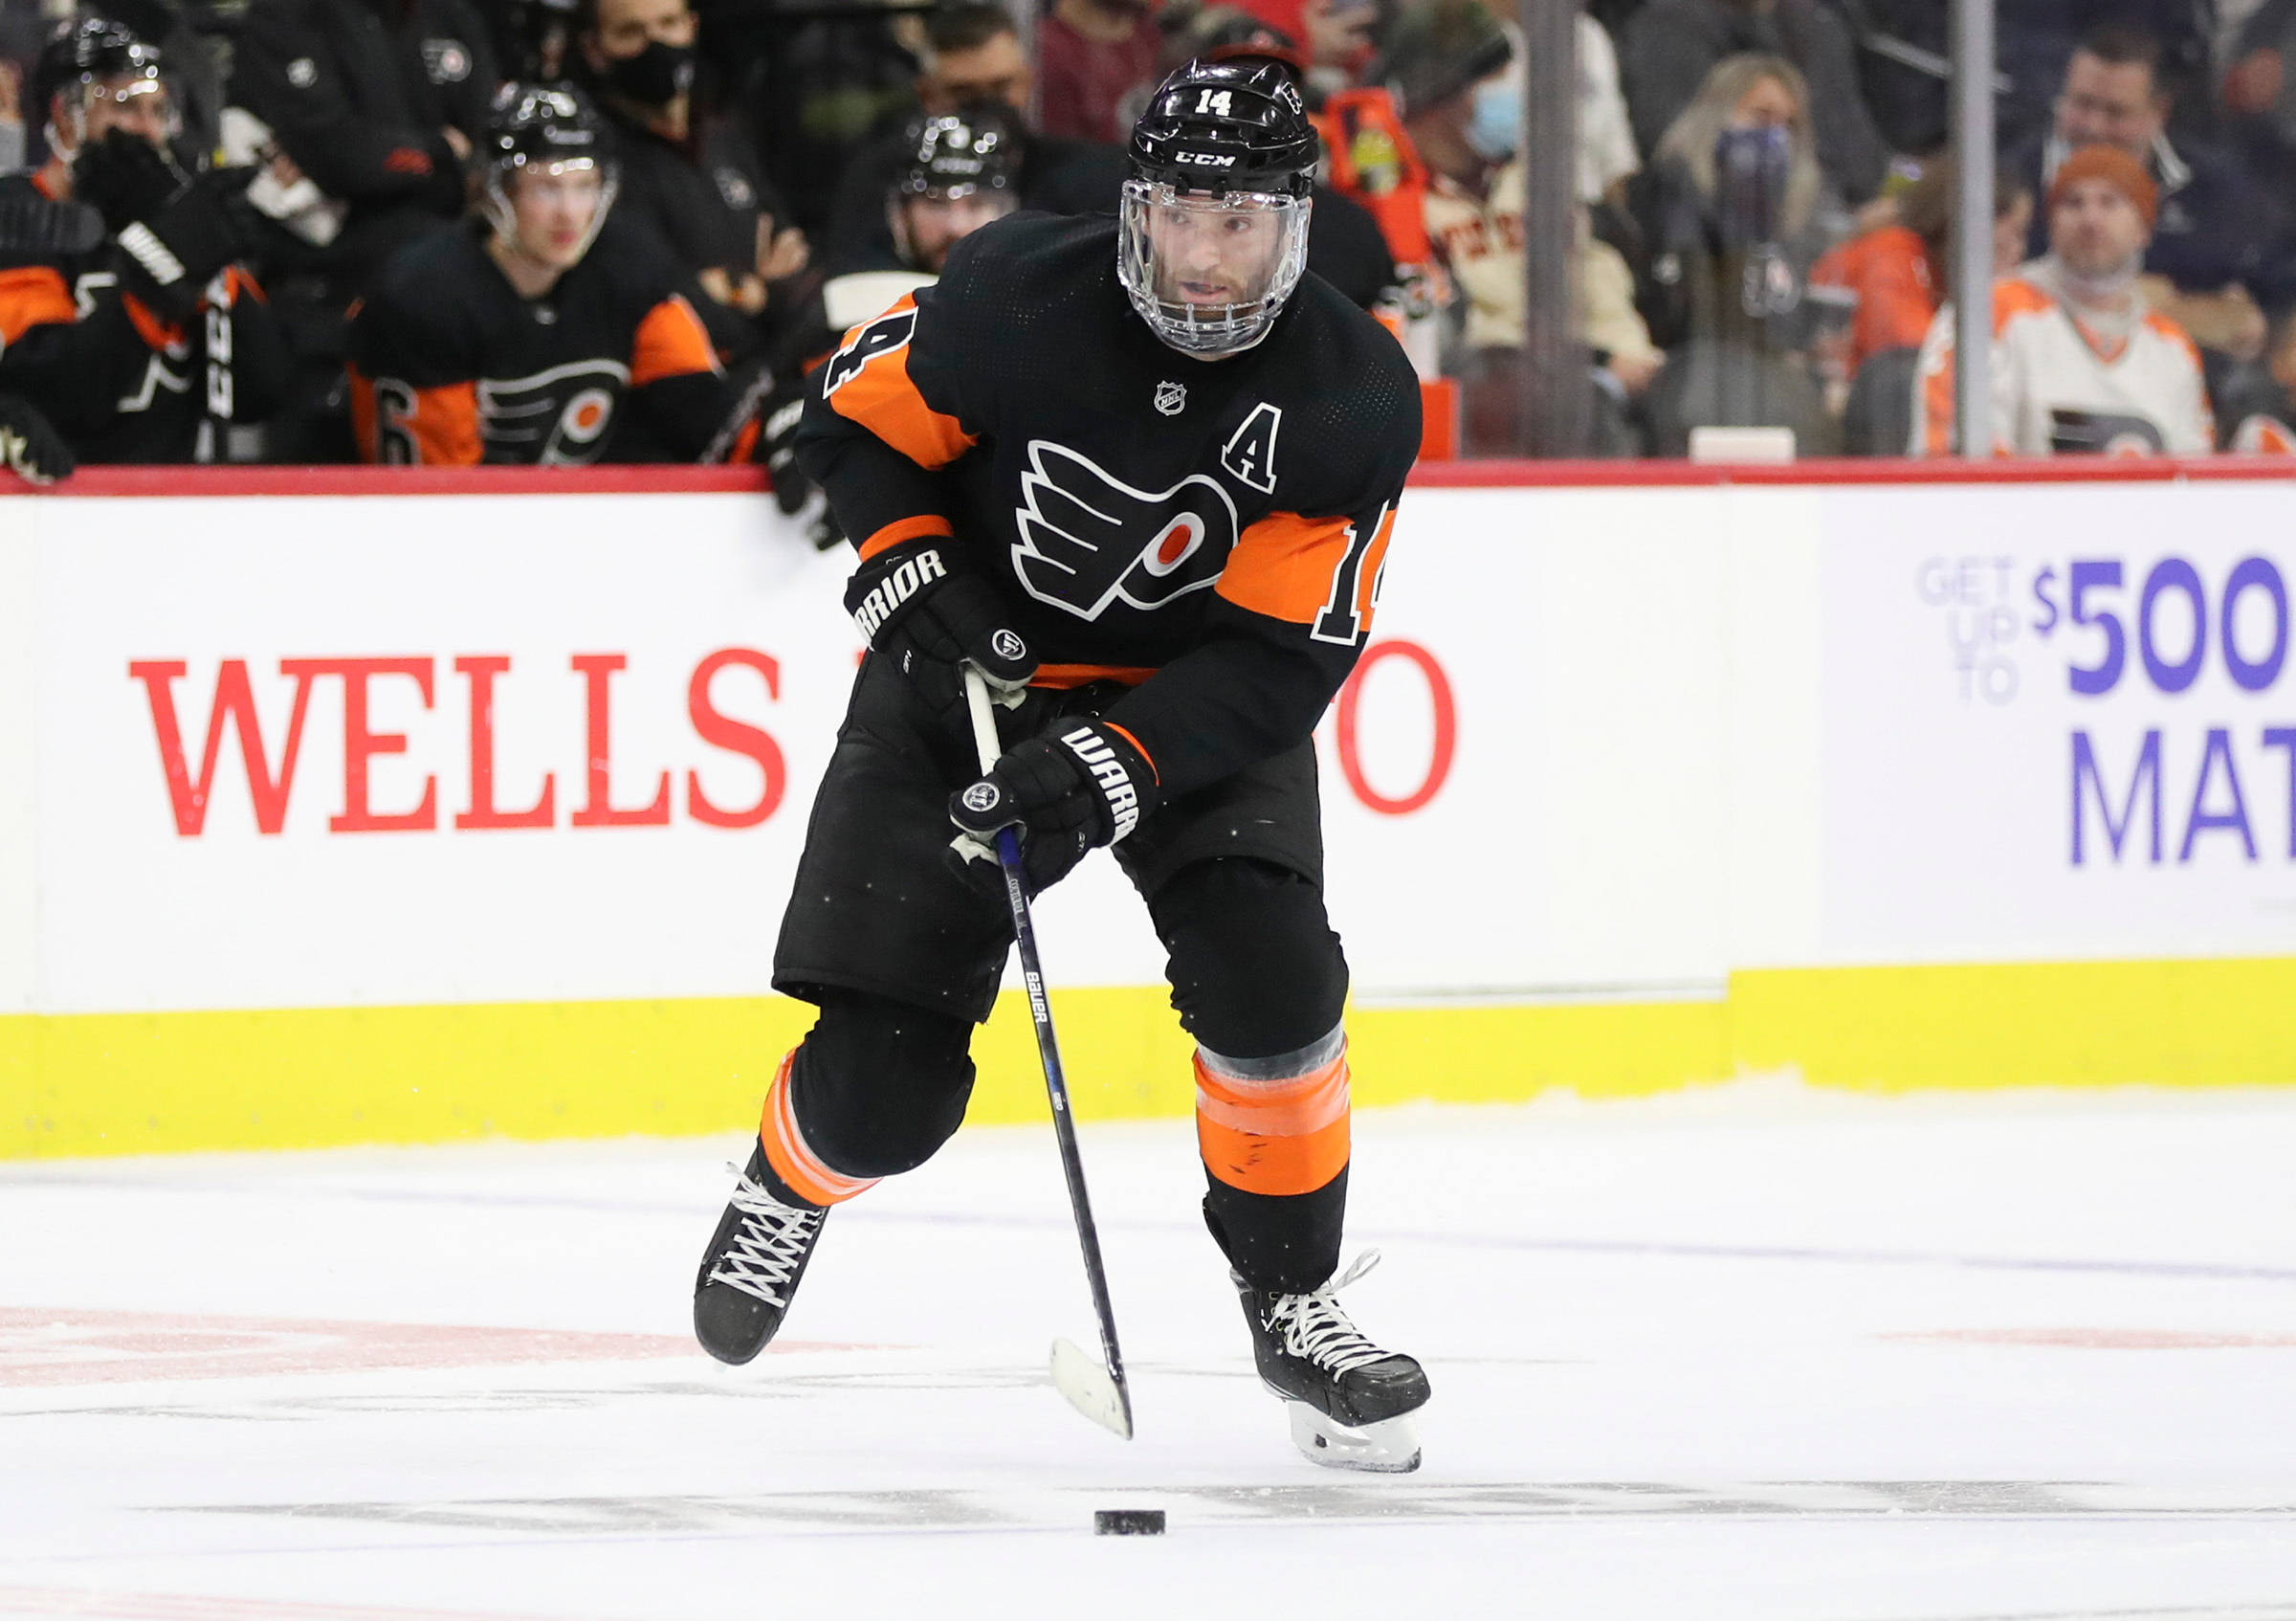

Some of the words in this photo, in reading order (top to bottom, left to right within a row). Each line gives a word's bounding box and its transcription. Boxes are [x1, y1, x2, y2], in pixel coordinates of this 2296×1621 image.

[1195, 88, 1232, 116] 14
[1175, 151, 1236, 167] CCM
[1221, 402, 1282, 495] A
[853, 549, 947, 652] RRIOR
[1917, 555, 2017, 607] GET
[1948, 607, 2020, 654] UP
[2033, 557, 2288, 695] $500
[1954, 655, 2020, 707] TO
[128, 647, 787, 836] WELLS
